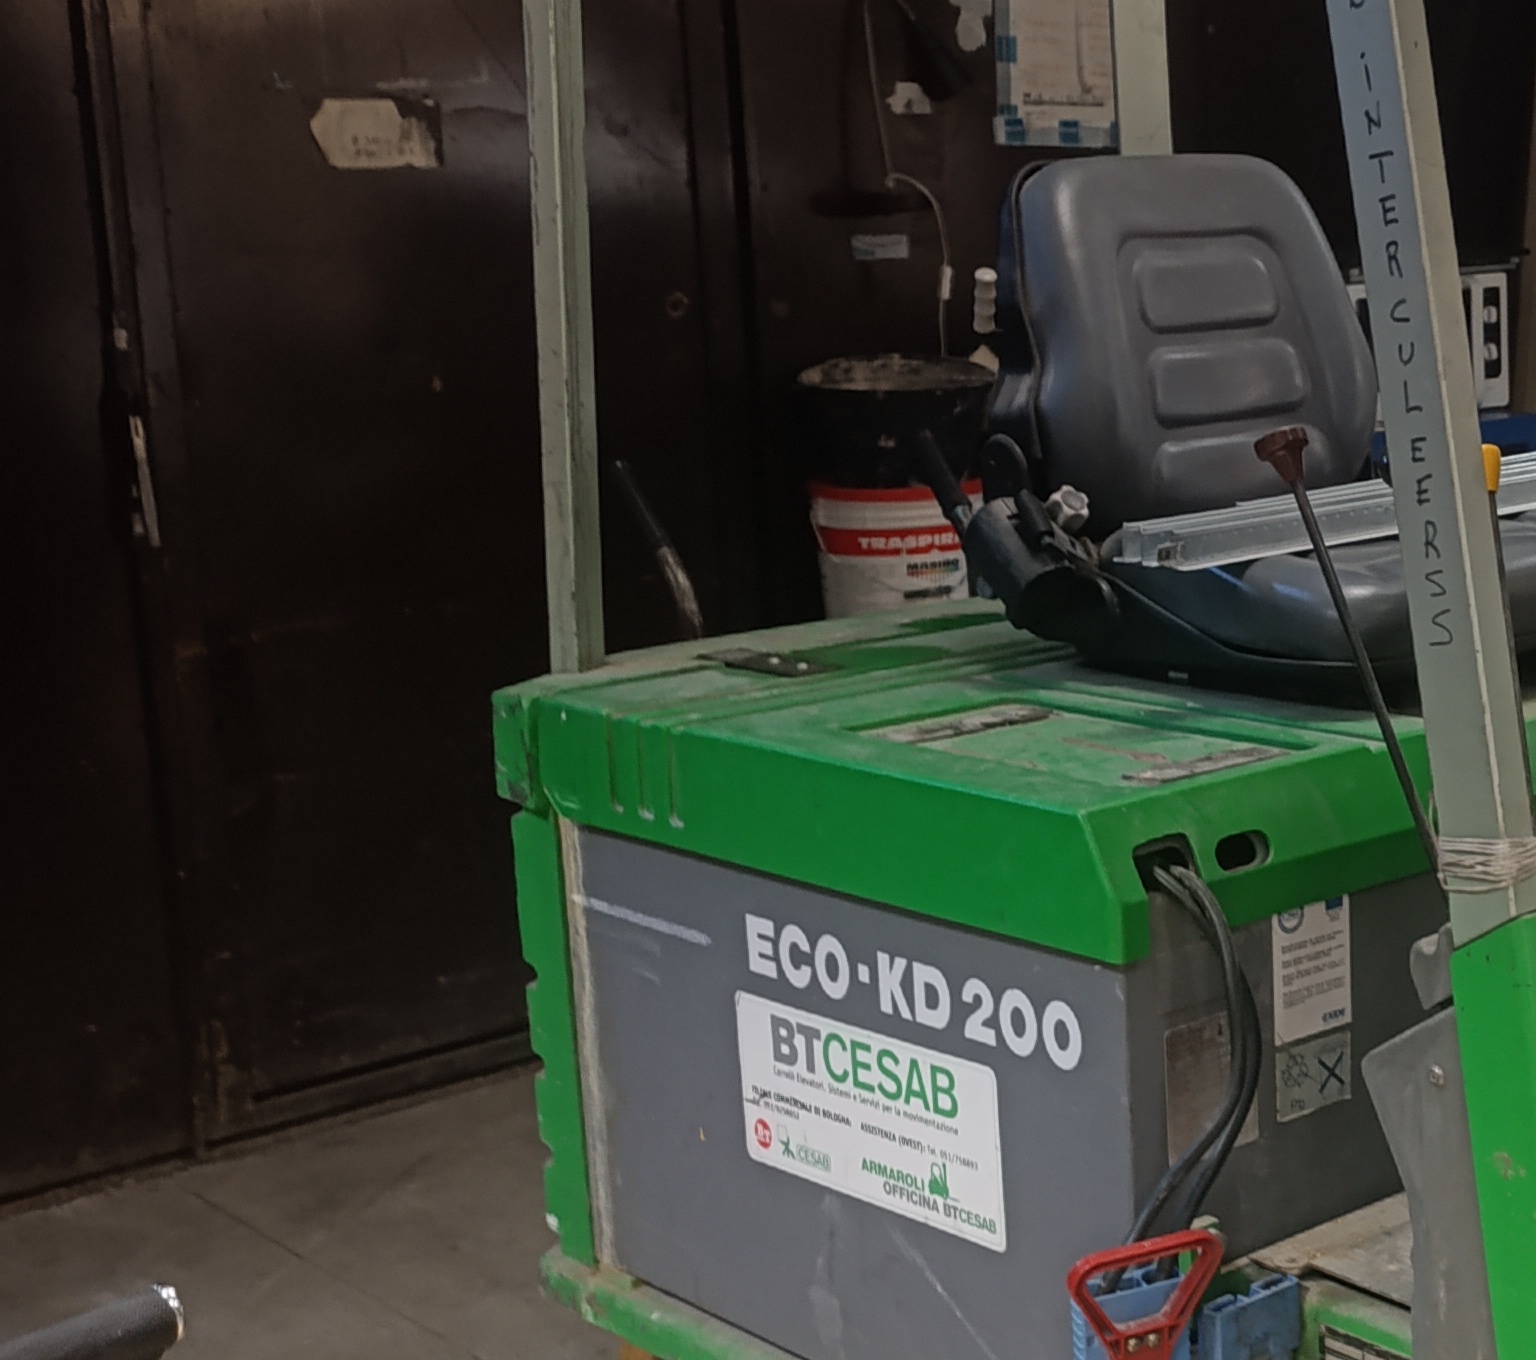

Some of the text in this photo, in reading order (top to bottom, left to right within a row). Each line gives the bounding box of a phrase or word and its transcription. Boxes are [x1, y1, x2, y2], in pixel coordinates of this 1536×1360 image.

[961, 977, 1082, 1071] 200
[769, 1013, 959, 1119] BTCESAB
[858, 1094, 880, 1109] Servizi
[882, 1101, 894, 1114] per
[903, 1109, 959, 1136] movimentazione
[860, 1122, 897, 1143] ASSISTENZA
[798, 1146, 830, 1169] CESAB
[861, 1157, 925, 1193] ARMAROLI
[883, 1180, 997, 1235] OFFICINA BTCESAB
